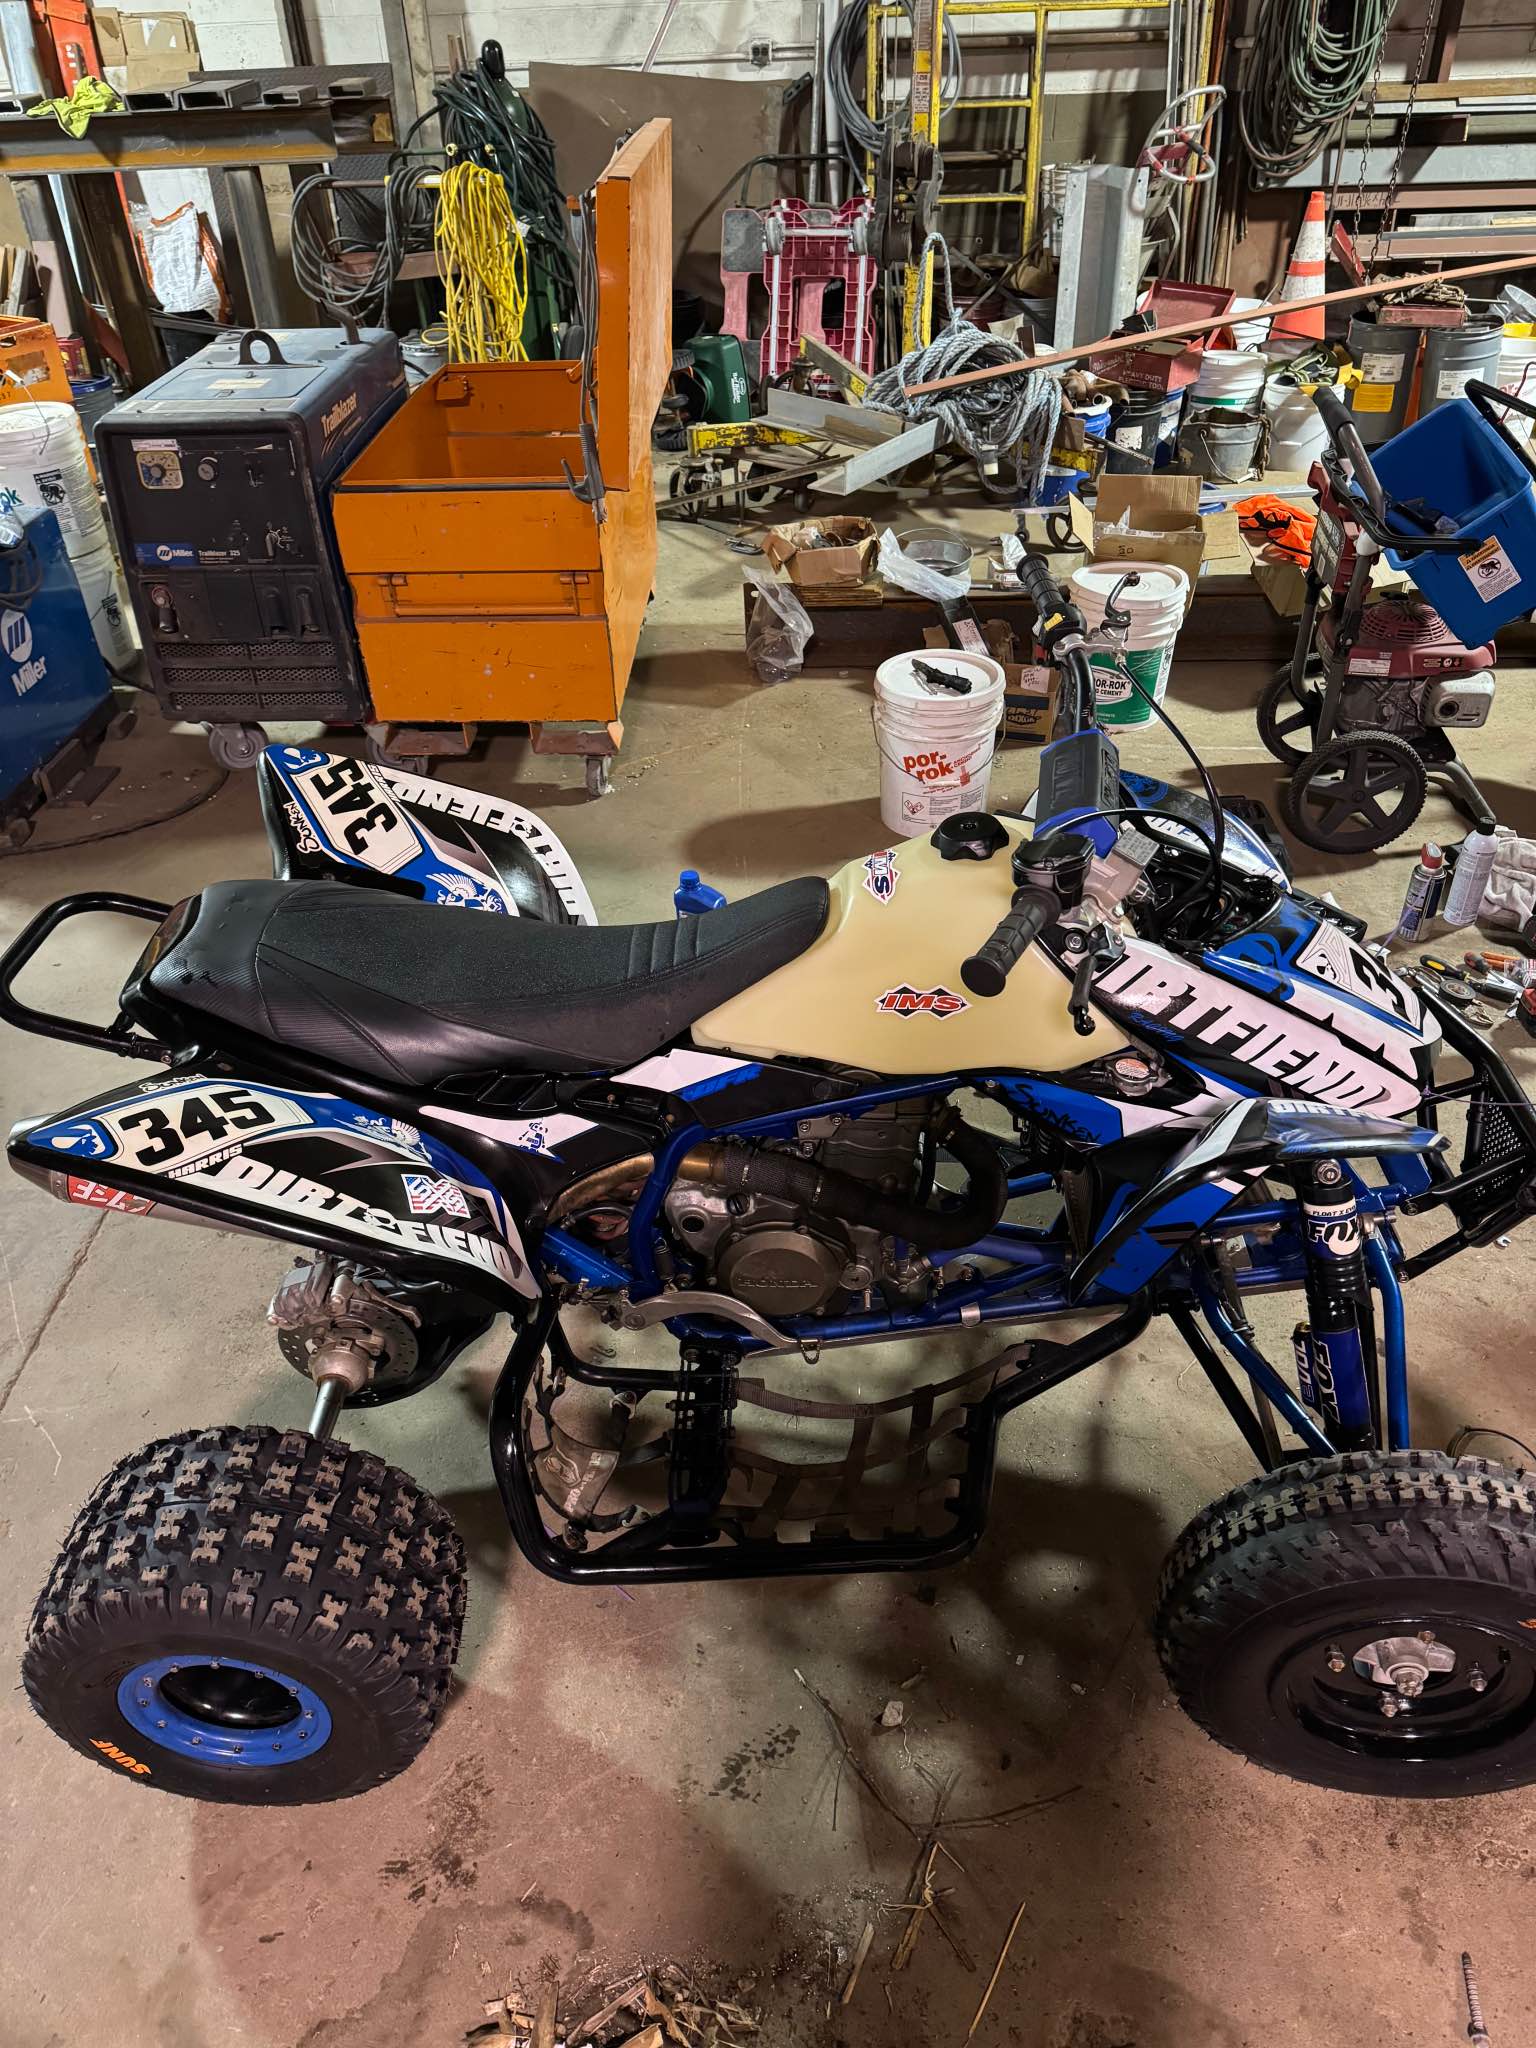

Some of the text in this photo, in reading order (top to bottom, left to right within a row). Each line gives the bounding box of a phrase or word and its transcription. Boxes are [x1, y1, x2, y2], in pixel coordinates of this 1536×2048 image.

[11, 657, 48, 697] Miller
[903, 751, 947, 773] por-
[309, 757, 398, 856] 345
[882, 993, 962, 1011] IMS
[118, 1088, 275, 1166] 345
[168, 1143, 243, 1180] HARRIS
[212, 1154, 519, 1274] DIRT FIEND
[1307, 1217, 1359, 1244] FOX
[1312, 1209, 1336, 1217] FLOAT
[1295, 1340, 1315, 1404] EVOL
[1312, 1340, 1341, 1425] FOX
